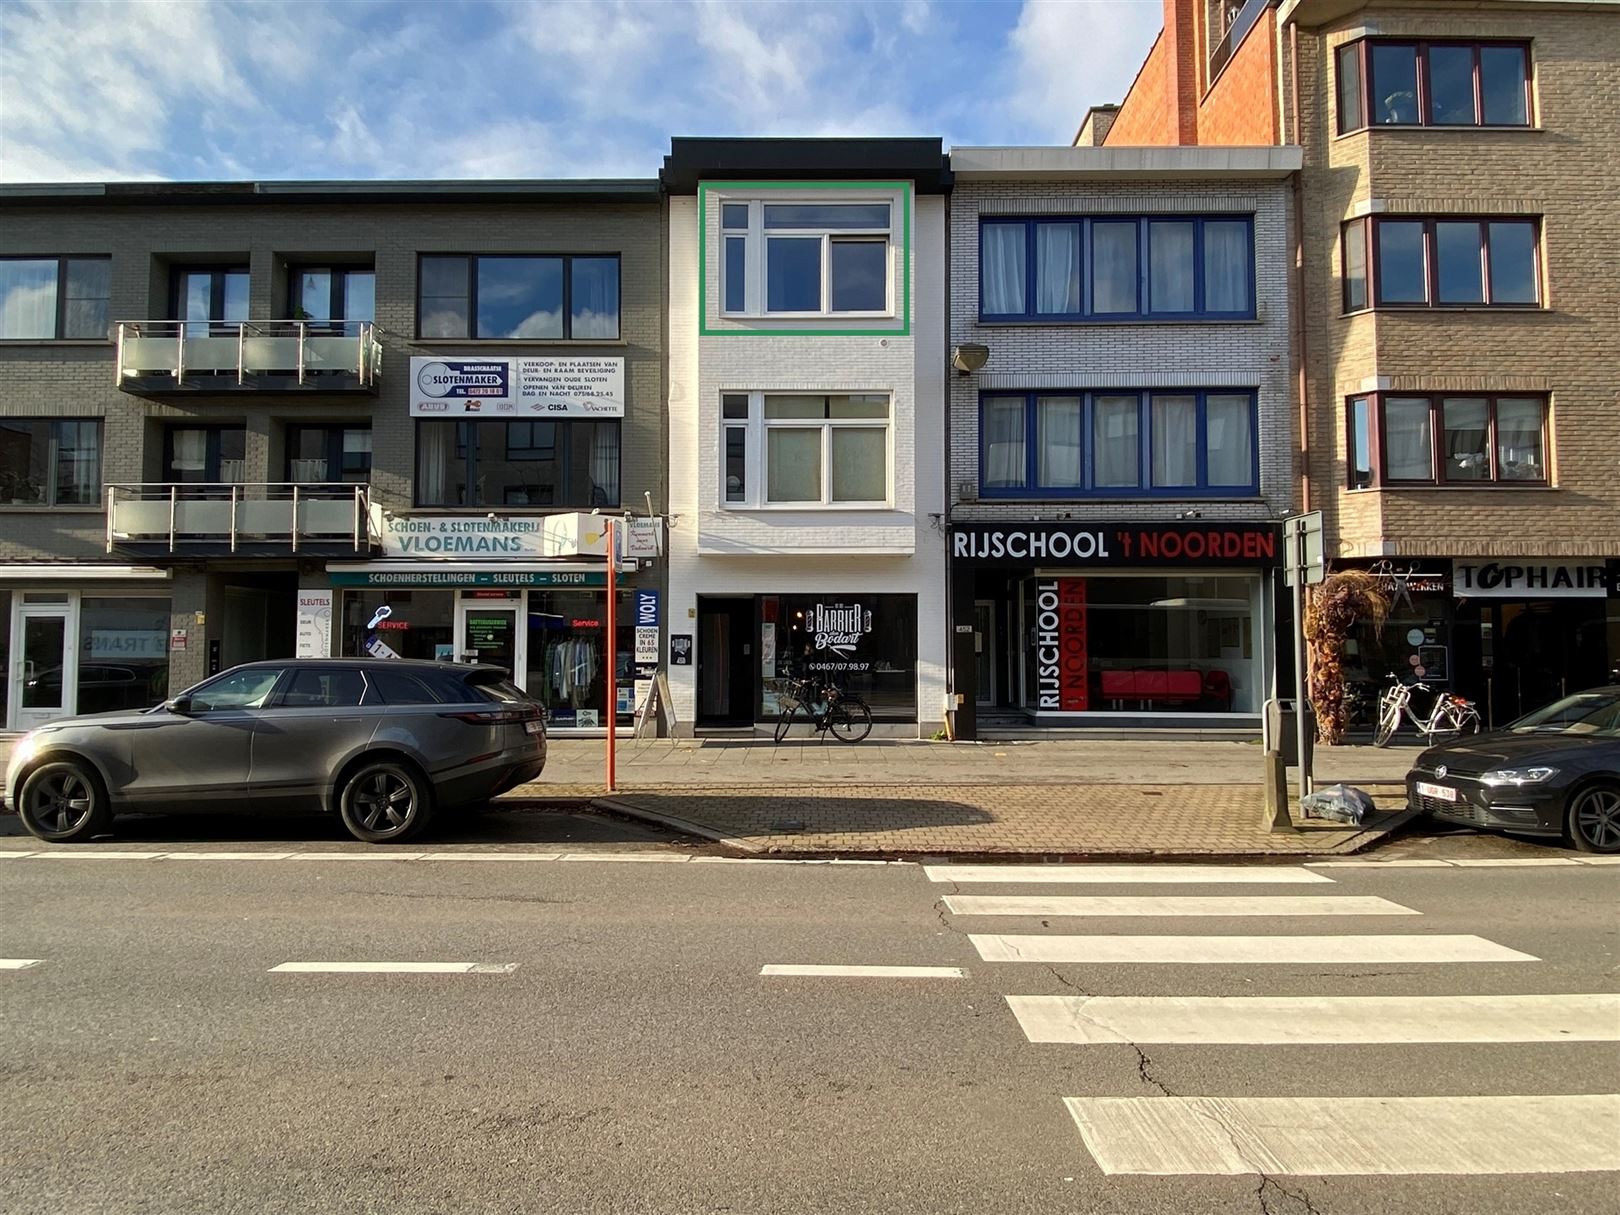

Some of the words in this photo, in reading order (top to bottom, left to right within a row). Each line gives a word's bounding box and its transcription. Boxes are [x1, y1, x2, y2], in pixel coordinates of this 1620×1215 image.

[433, 375, 498, 384] SLOTENMAKER
[388, 521, 436, 533] SCHOEN-
[439, 522, 447, 532] &
[450, 521, 540, 533] SLOTENMAKERIJ
[398, 536, 522, 552] VLOEMANS
[954, 531, 1109, 558] RIJSCHOOL
[1140, 531, 1275, 558] NOORDEN
[368, 573, 476, 583] SCHOENHERSTELLINGEN
[493, 573, 535, 584] SLEUTELS
[551, 573, 585, 583] SLOTEN
[1458, 562, 1607, 589] TOPHAIR
[299, 598, 330, 606] SLEUTELS
[639, 593, 656, 624] WOLY
[377, 621, 409, 630] SERVICE
[572, 619, 599, 627] Service
[816, 603, 862, 633] BARBIER
[814, 632, 863, 650] Bodart
[1063, 581, 1084, 686] NOORDEN
[1038, 581, 1059, 708] RIJSCHOOL
[816, 662, 870, 671] 0467/07.98.97
